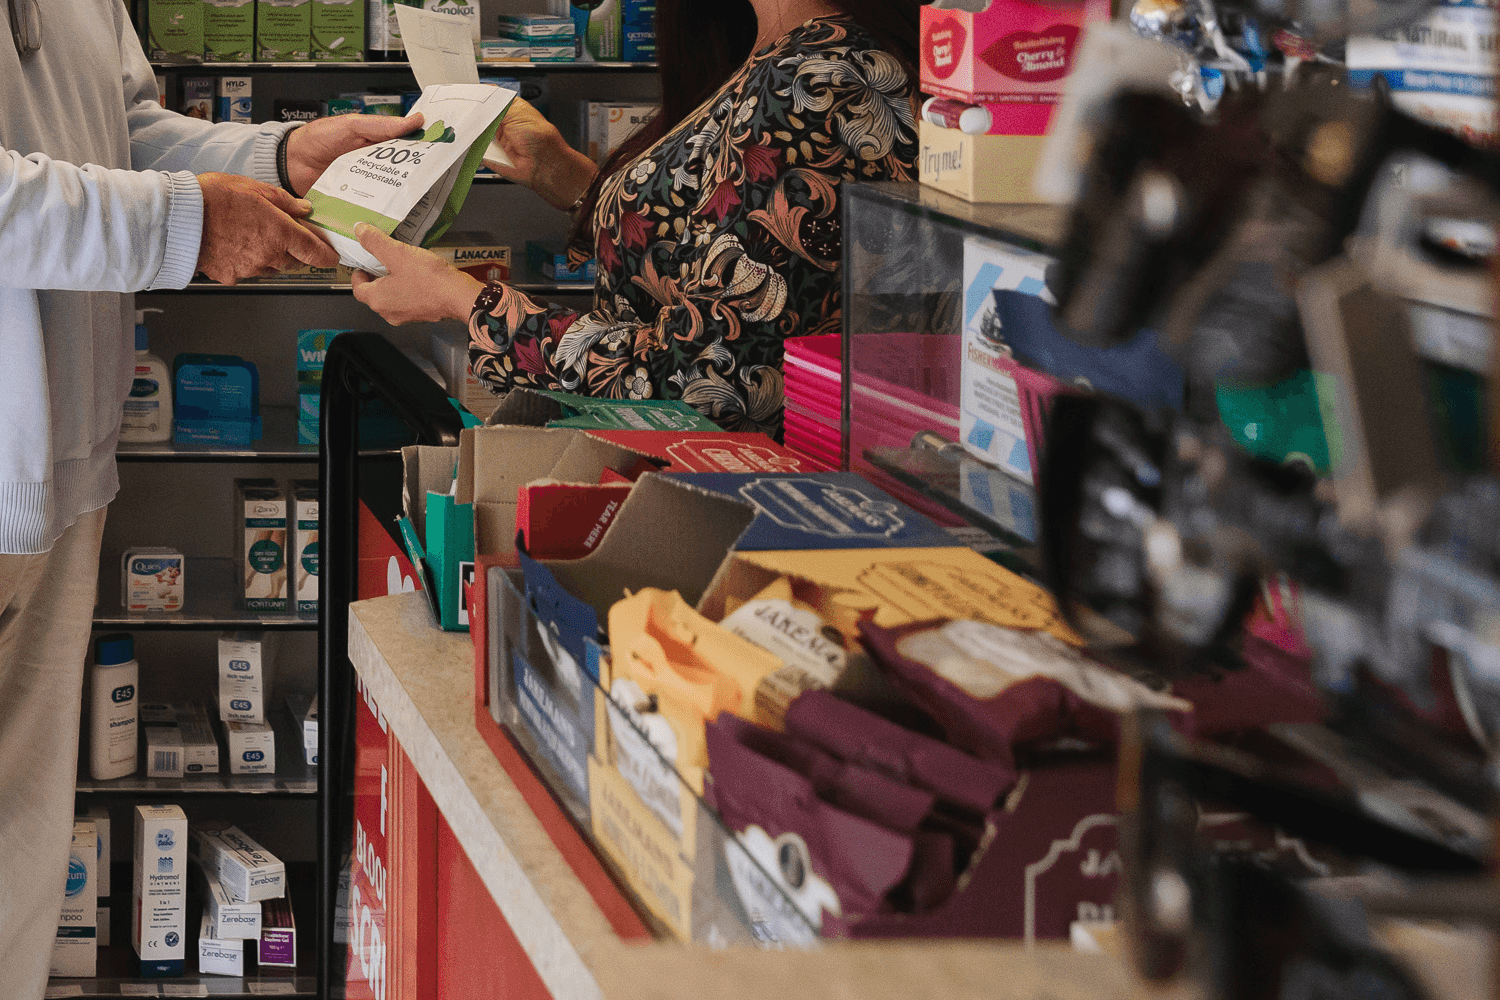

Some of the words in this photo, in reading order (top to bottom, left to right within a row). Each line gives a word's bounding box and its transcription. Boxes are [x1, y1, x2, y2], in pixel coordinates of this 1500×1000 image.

[431, 5, 475, 15] Senokot
[1021, 58, 1064, 73] Almond
[281, 109, 318, 120] Systane
[367, 146, 425, 166] 100%
[922, 144, 941, 174] Try
[941, 142, 963, 181] me!
[349, 165, 402, 188] Compostable
[454, 249, 507, 260] LANACANE
[310, 266, 337, 274] Cream
[602, 500, 618, 523] TEAR
[583, 522, 603, 548] HERE
[134, 561, 161, 571] Quies
[115, 688, 133, 699] E45
[110, 717, 135, 728] shampoo
[245, 752, 261, 761] E45
[149, 874, 180, 882] Hydromol
[250, 874, 281, 886] Zerobase
[221, 915, 256, 925] Zerobase
